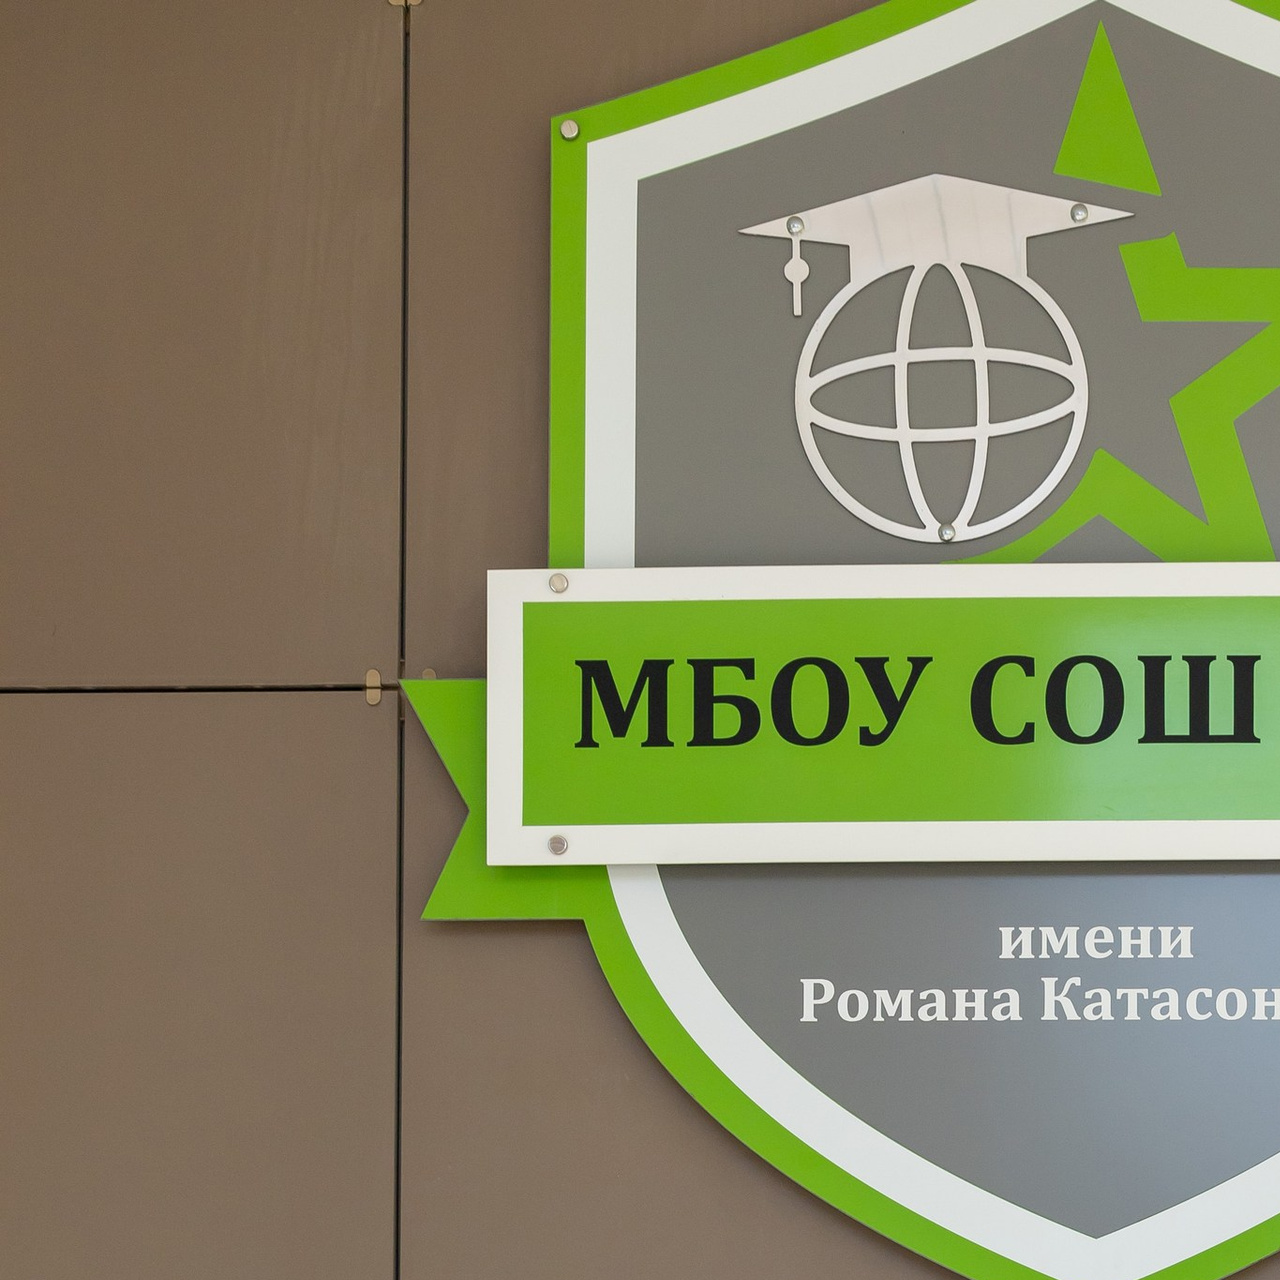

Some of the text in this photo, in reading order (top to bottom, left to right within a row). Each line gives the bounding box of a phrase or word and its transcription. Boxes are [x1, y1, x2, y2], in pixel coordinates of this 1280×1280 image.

[574, 657, 934, 749] МБОУ
[970, 655, 1262, 747] СОШ
[998, 926, 1194, 959] имени
[799, 978, 1023, 1023] Романа
